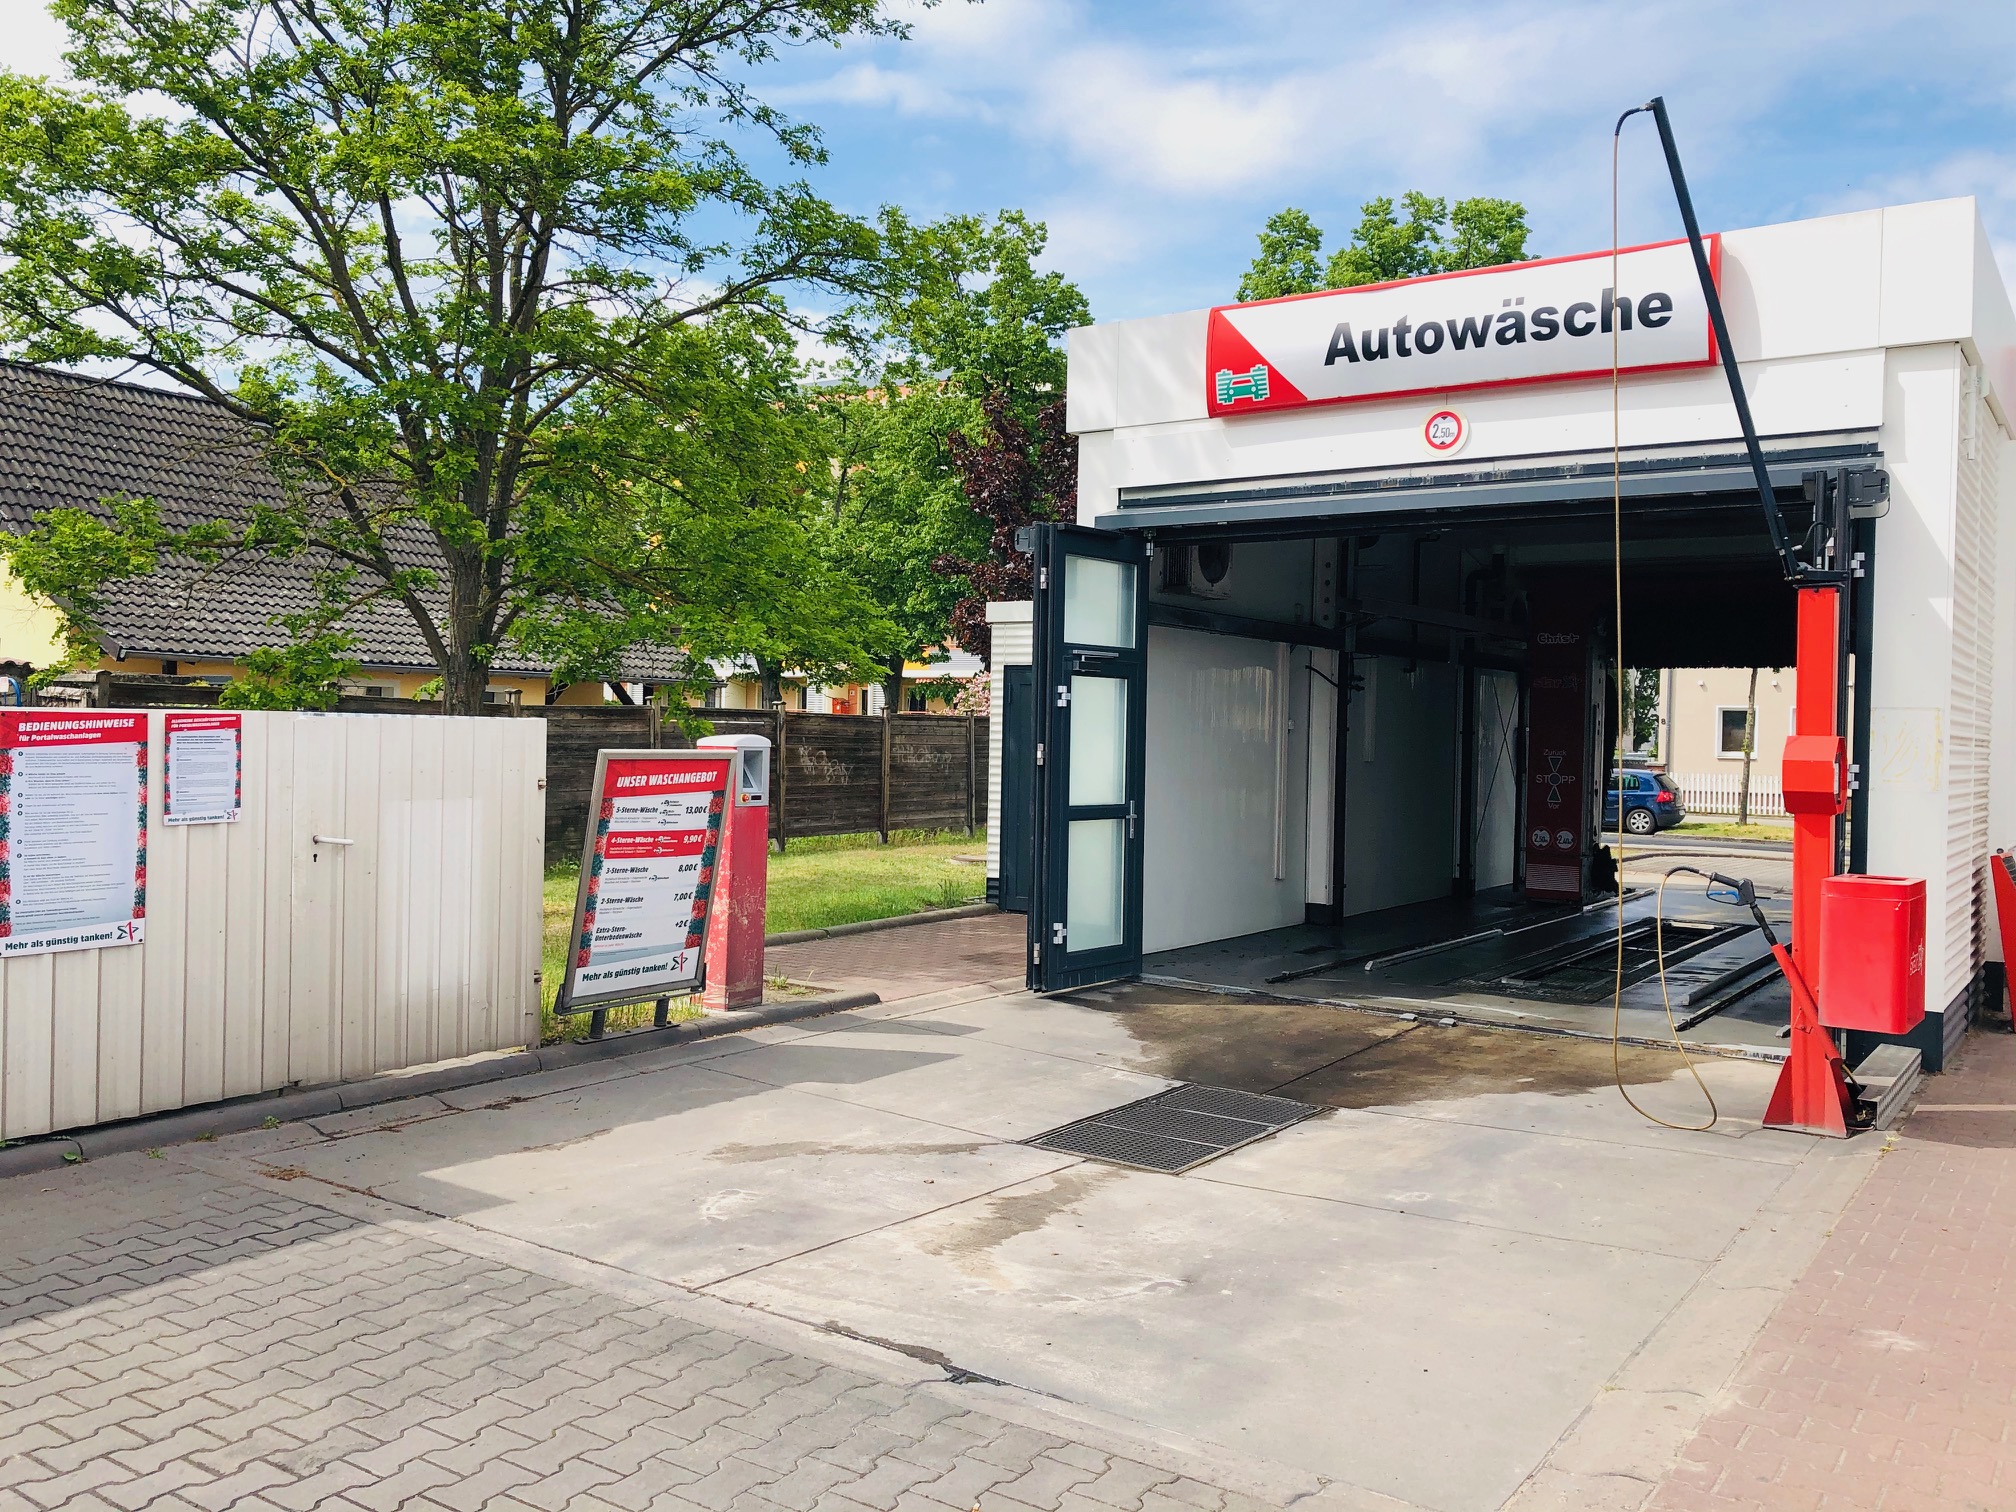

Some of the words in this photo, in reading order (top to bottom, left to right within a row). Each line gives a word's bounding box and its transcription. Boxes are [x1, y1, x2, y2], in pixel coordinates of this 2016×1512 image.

[1324, 287, 1674, 366] Autowäsche
[1537, 632, 1580, 644] Christ
[18, 718, 135, 732] BEDIENUNGSHINWEISE
[18, 734, 30, 742] für
[31, 732, 102, 742] Portalwaschanlagen
[616, 775, 648, 788] UNSER
[648, 771, 718, 786] WASCHANGEBOT
[1536, 772, 1576, 786] STOPP
[616, 806, 659, 814] 5-Sterne-Wäsche
[611, 835, 654, 844] 4-Sterne-Wäsche
[606, 866, 649, 875] 3-Sterne-Wäsche
[600, 896, 644, 904] 2-Sterne-Wäsche
[596, 925, 627, 934] Extra-Stern-
[5, 941, 29, 950] Mehr
[31, 939, 44, 948] als
[46, 934, 79, 947] günstig
[81, 932, 113, 942] tanken!
[595, 932, 643, 942] Unterbodenwäsche
[582, 973, 602, 982] Mehr
[603, 970, 613, 979] als
[614, 967, 641, 979] günstig
[642, 962, 668, 973] tanken!
